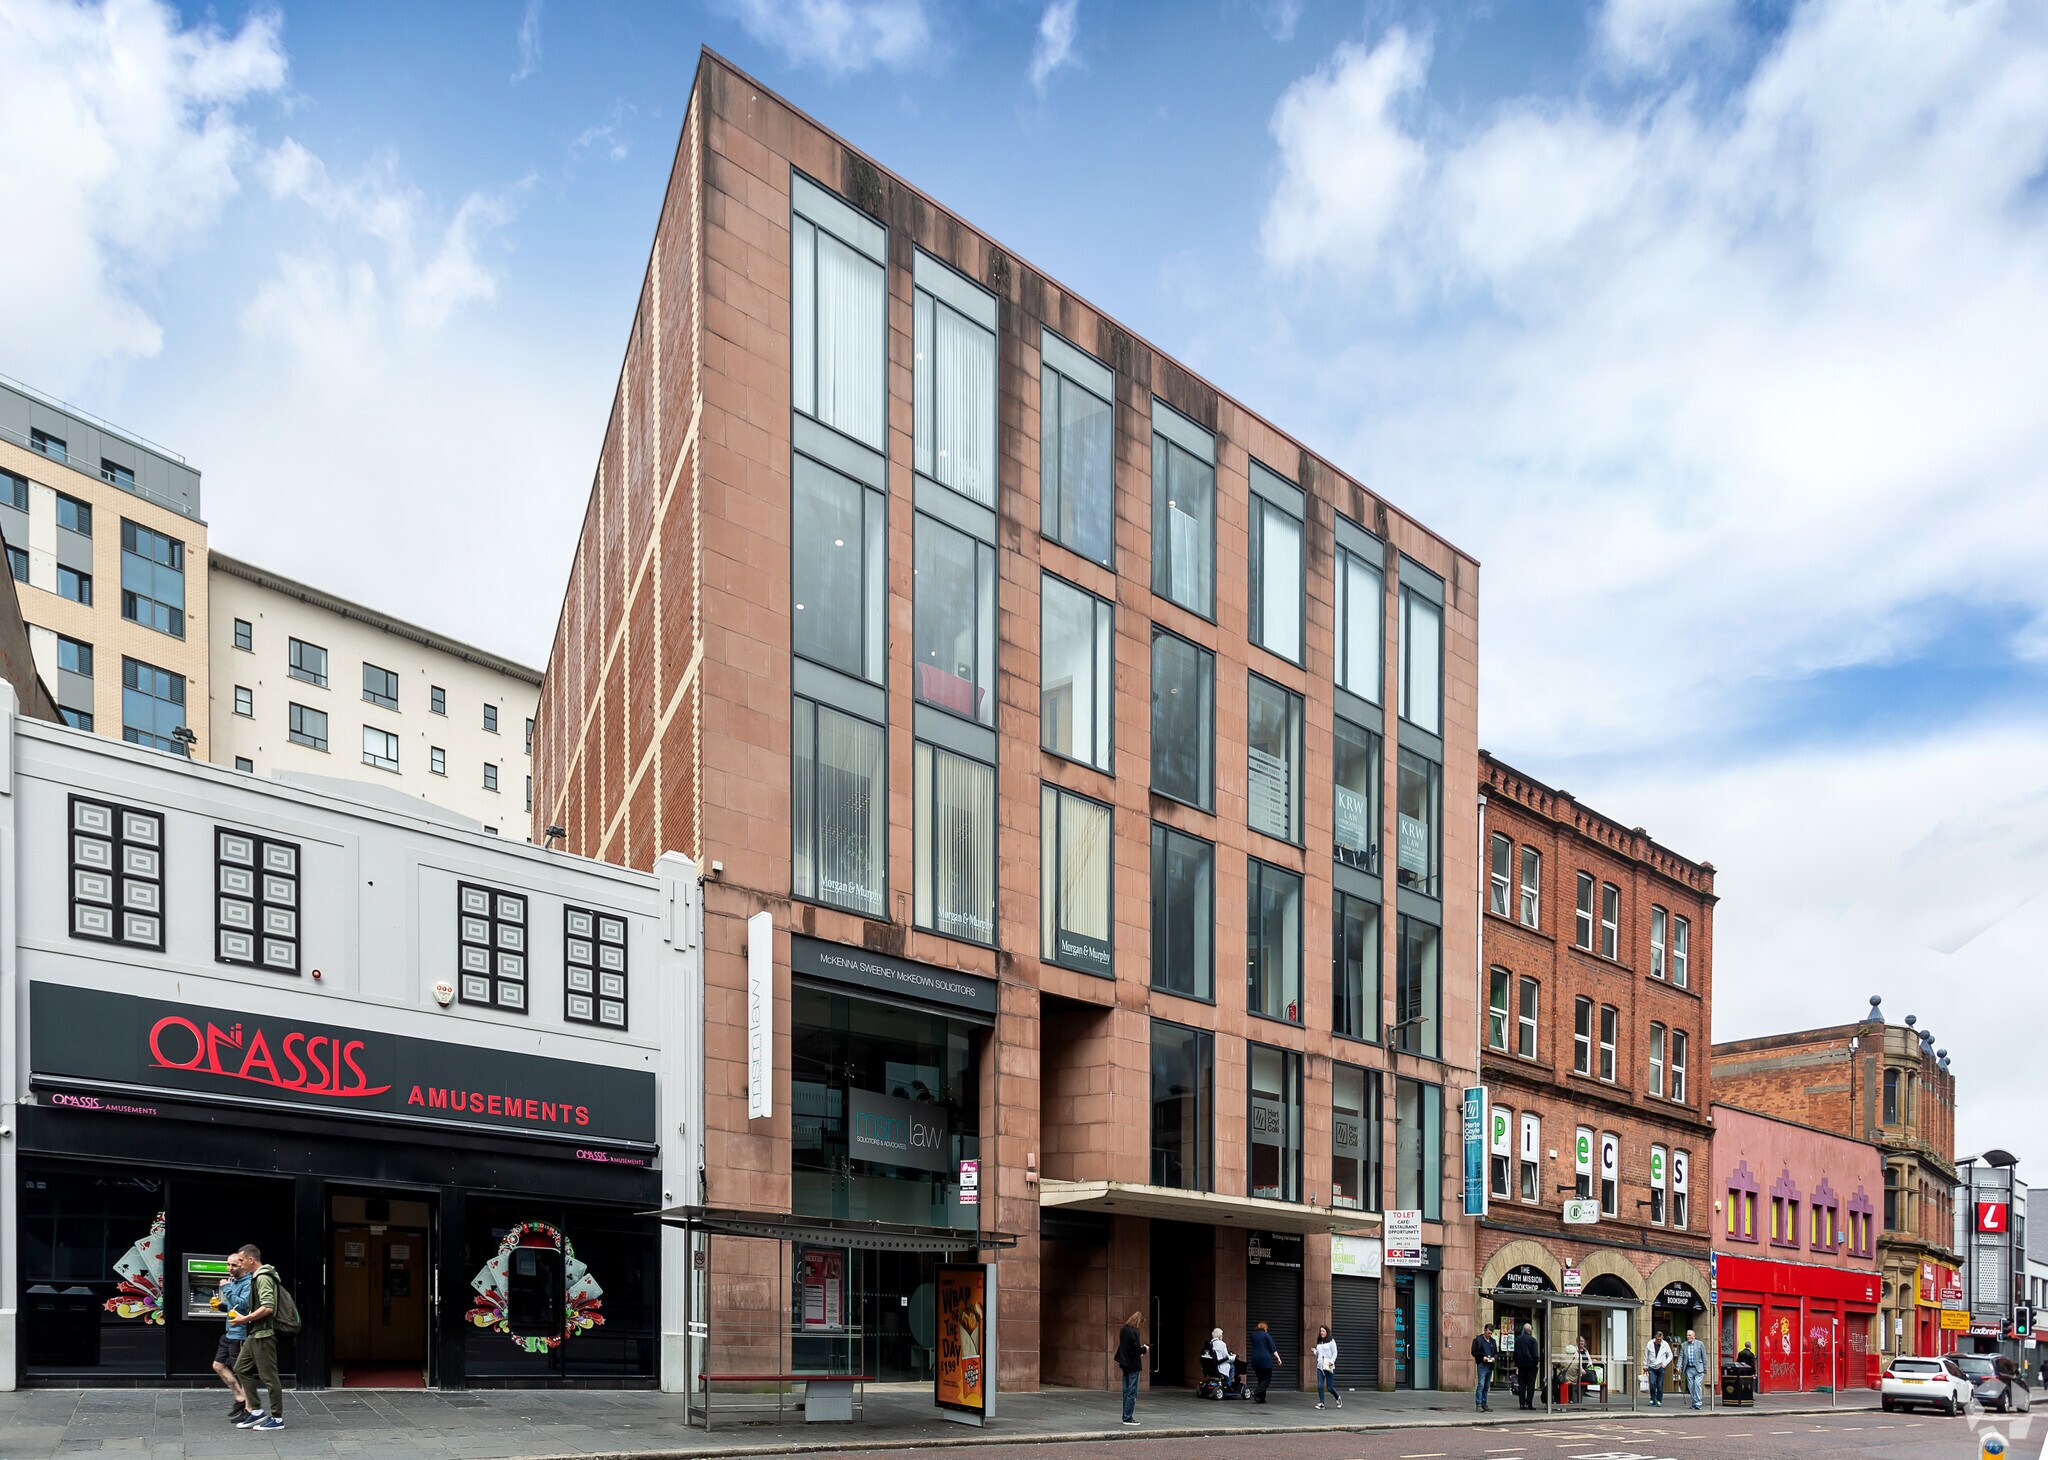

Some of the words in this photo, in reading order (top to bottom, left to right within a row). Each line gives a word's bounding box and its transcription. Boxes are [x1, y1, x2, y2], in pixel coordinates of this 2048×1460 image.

[1338, 792, 1364, 815] KRW
[1344, 810, 1359, 822] LAW
[1401, 819, 1425, 841] KRW
[1406, 837, 1420, 849] LAW
[820, 874, 848, 894] Morgan
[848, 881, 856, 894] &
[855, 883, 883, 904] Murphy
[938, 905, 963, 925] Morgan
[962, 912, 969, 925] &
[969, 913, 994, 933] Murphy
[1061, 939, 1083, 957] Morgan
[1083, 944, 1089, 957] &
[1089, 946, 1110, 964] Murphy
[820, 953, 859, 971] McKENNA
[859, 961, 896, 979] SWEENEY
[896, 971, 934, 988] McKEOWN
[934, 979, 976, 997] SOLICITORS
[148, 1015, 392, 1097] ONASSIS
[52, 1093, 104, 1109] ONASSIS
[105, 1104, 157, 1115] AMUSEMENTS
[407, 1084, 590, 1126] AMUSEMENTS
[856, 1111, 907, 1145] msm
[909, 1114, 943, 1150] law
[1465, 1127, 1481, 1135] Coyle
[857, 1135, 880, 1146] SOLICITORS
[884, 1141, 907, 1151] ADVOCATES
[610, 1157, 645, 1166] AMUSEMENTS
[1393, 1211, 1402, 1219] TO
[1403, 1211, 1415, 1219] LET
[1249, 1246, 1271, 1258] GREENHOUSE
[1332, 1252, 1356, 1265] GREENHOUSE
[1520, 1265, 1530, 1274] THE
[1507, 1273, 1522, 1282] FAITH
[1522, 1275, 1543, 1284] MISSION
[1511, 1282, 1539, 1291] BOOKSHOP
[1673, 1282, 1682, 1290] THE
[942, 1286, 971, 1314] WRAP
[1663, 1288, 1676, 1296] FAITH
[1675, 1289, 1692, 1298] MISSION
[1667, 1296, 1689, 1305] BOOKSHOP
[944, 1319, 958, 1342] THE
[943, 1338, 961, 1367] DAY
